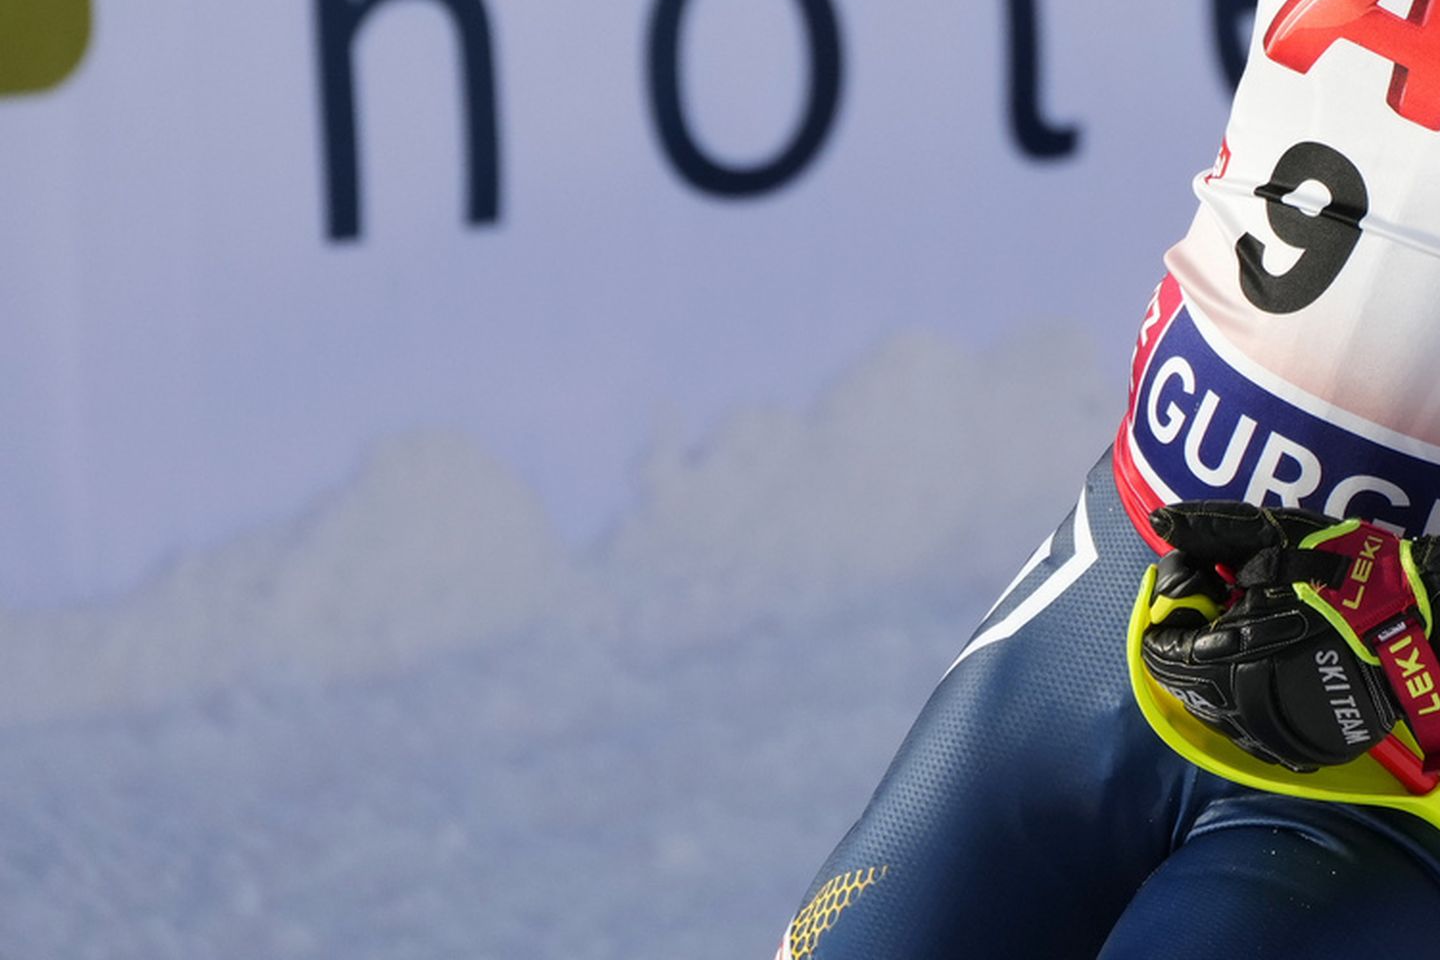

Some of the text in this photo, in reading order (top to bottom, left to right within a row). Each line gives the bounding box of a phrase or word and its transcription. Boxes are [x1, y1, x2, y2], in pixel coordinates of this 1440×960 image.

[1236, 141, 1369, 315] 9
[1342, 535, 1384, 610] LEKI
[1314, 649, 1371, 745] SKI TEAM
